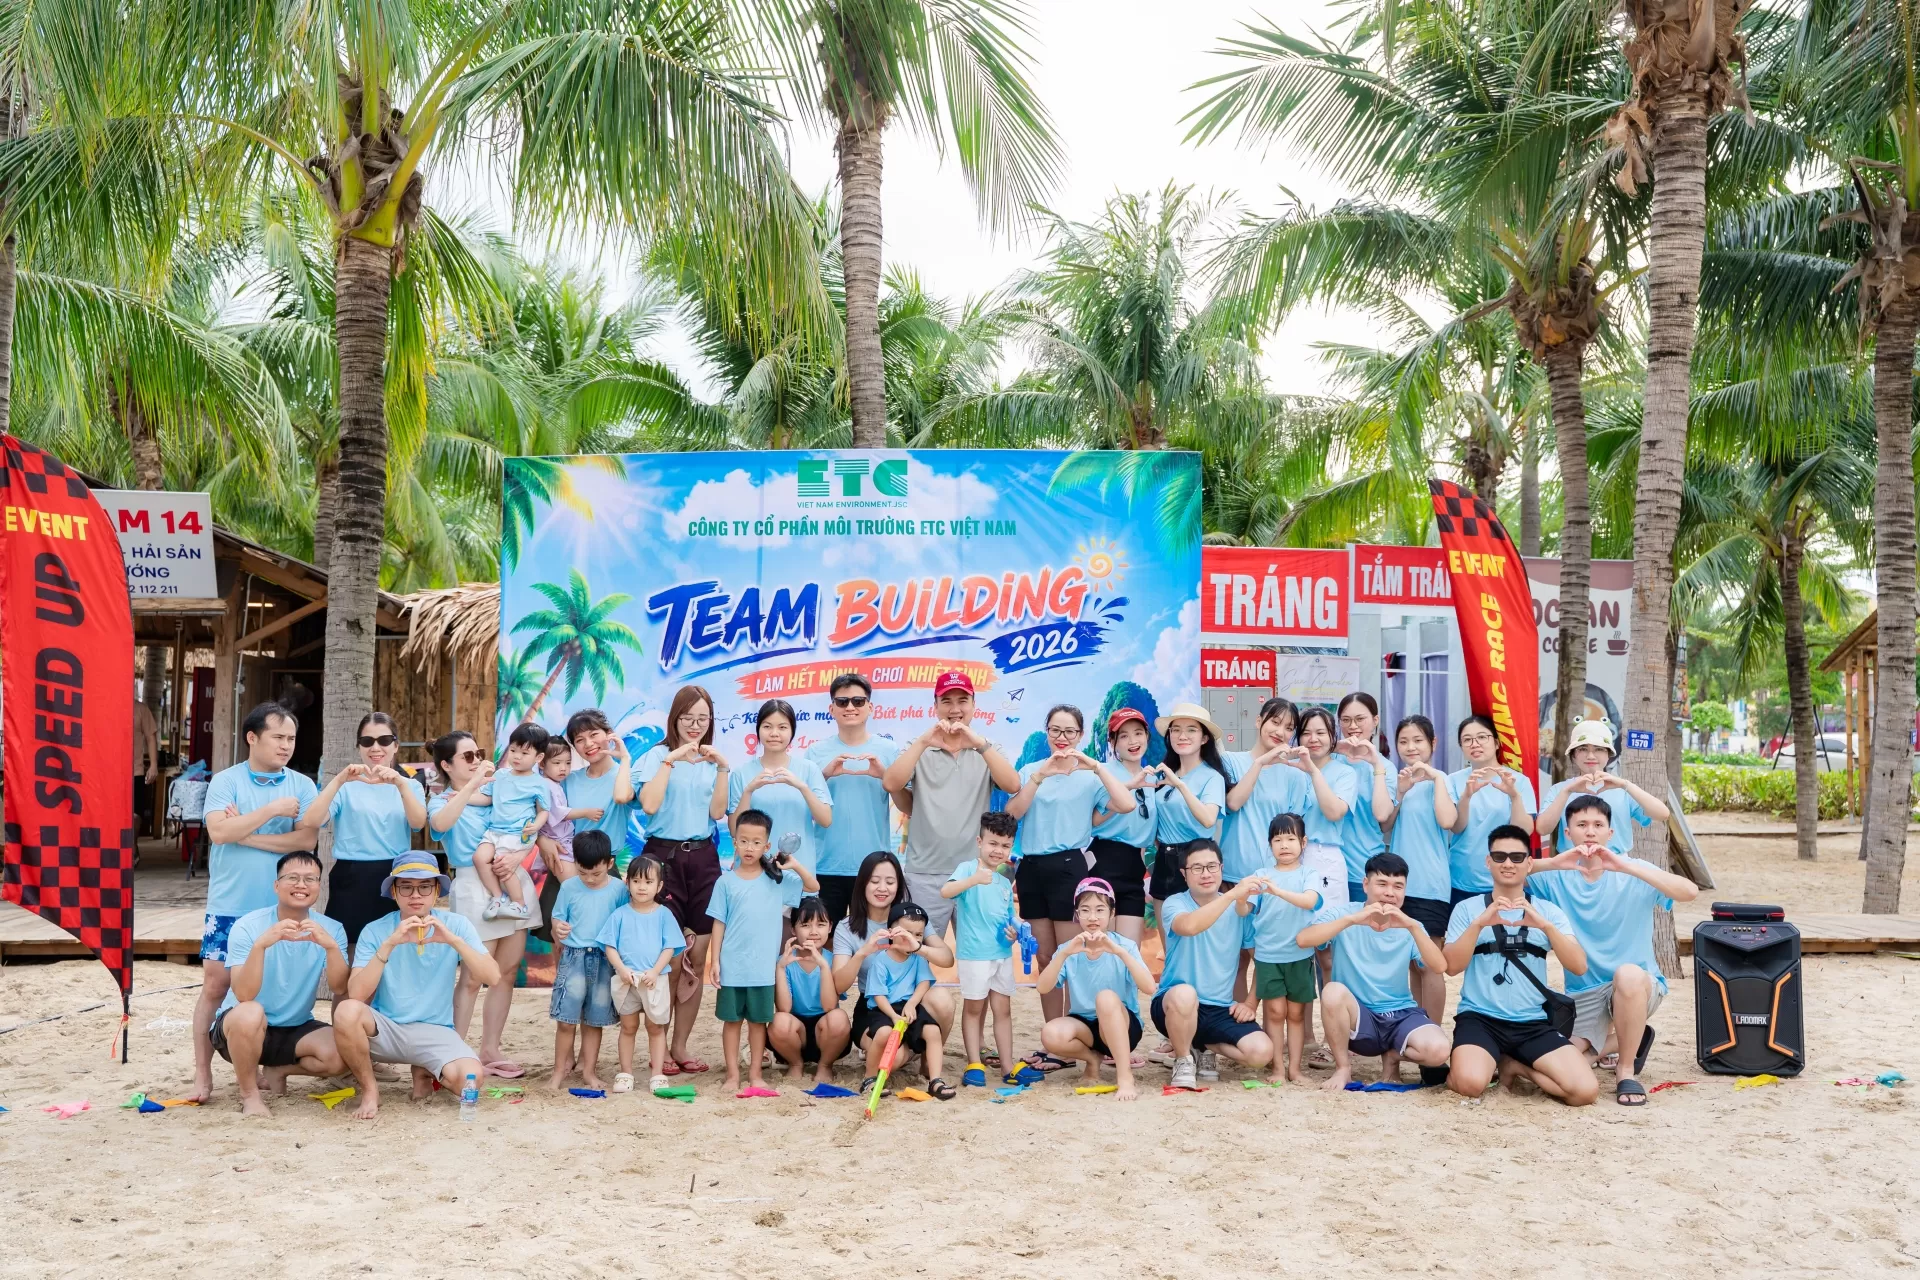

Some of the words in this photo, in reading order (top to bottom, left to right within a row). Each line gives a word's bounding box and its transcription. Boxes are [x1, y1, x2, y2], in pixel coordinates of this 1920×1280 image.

[797, 459, 908, 497] ETC
[797, 501, 814, 509] VIET
[5, 506, 89, 541] EVENT
[161, 510, 204, 535] 14
[688, 516, 728, 537] CÔNG
[733, 520, 750, 536] TY
[754, 514, 774, 536] CỔ
[779, 514, 819, 536] PHẦN
[824, 515, 850, 536] MÔI
[856, 515, 915, 536] TRƯỜNG
[921, 519, 945, 536] ETC
[950, 515, 980, 539] VIỆT
[985, 519, 1017, 536] NAM
[131, 542, 162, 559] HẢI
[165, 543, 202, 560] SẢN
[1449, 550, 1506, 579] EVENT
[35, 551, 85, 628] UP
[139, 585, 158, 594] 112
[160, 585, 178, 594] 211
[1360, 552, 1404, 597] TẮM
[1210, 564, 1339, 630] TRÁNG
[647, 580, 820, 668] TEAM
[1481, 592, 1506, 672] RACE
[1008, 626, 1079, 665] 2026
[755, 674, 785, 694] LÀM
[787, 665, 817, 690] HẾT
[872, 665, 904, 683] CHƠI
[907, 661, 952, 685] NHIỆ
[954, 663, 989, 687] ÌNH
[1203, 656, 1270, 681] TRÁNG
[900, 705, 924, 722] phá
[34, 647, 85, 816] SPEED
[1631, 738, 1649, 748] 1570
